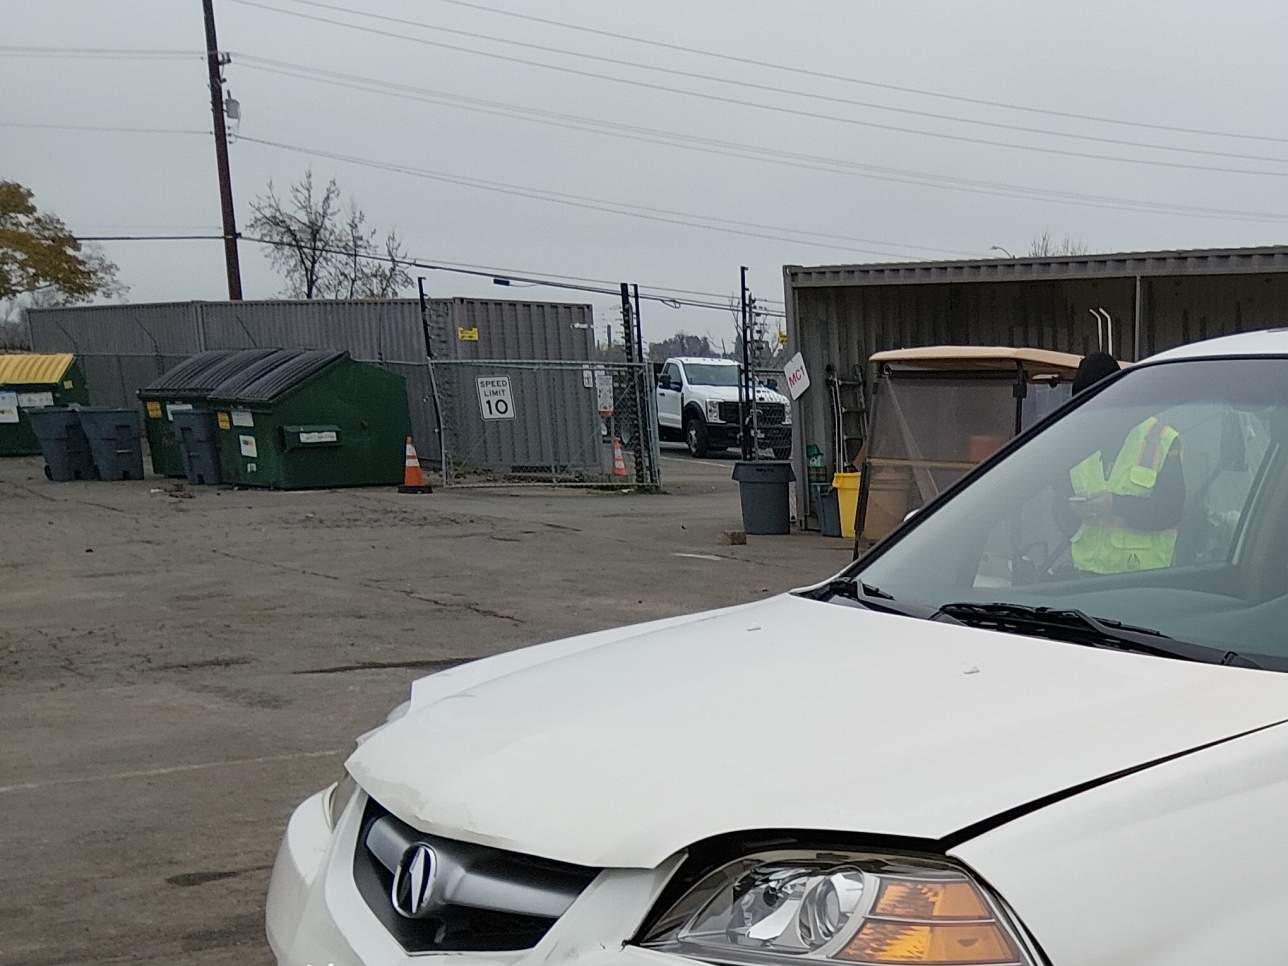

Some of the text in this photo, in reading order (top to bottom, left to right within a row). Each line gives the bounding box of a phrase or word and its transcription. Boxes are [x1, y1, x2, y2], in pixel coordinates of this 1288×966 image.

[480, 380, 507, 388] SPEED
[484, 389, 505, 397] LIMIT
[486, 399, 508, 415] 10
